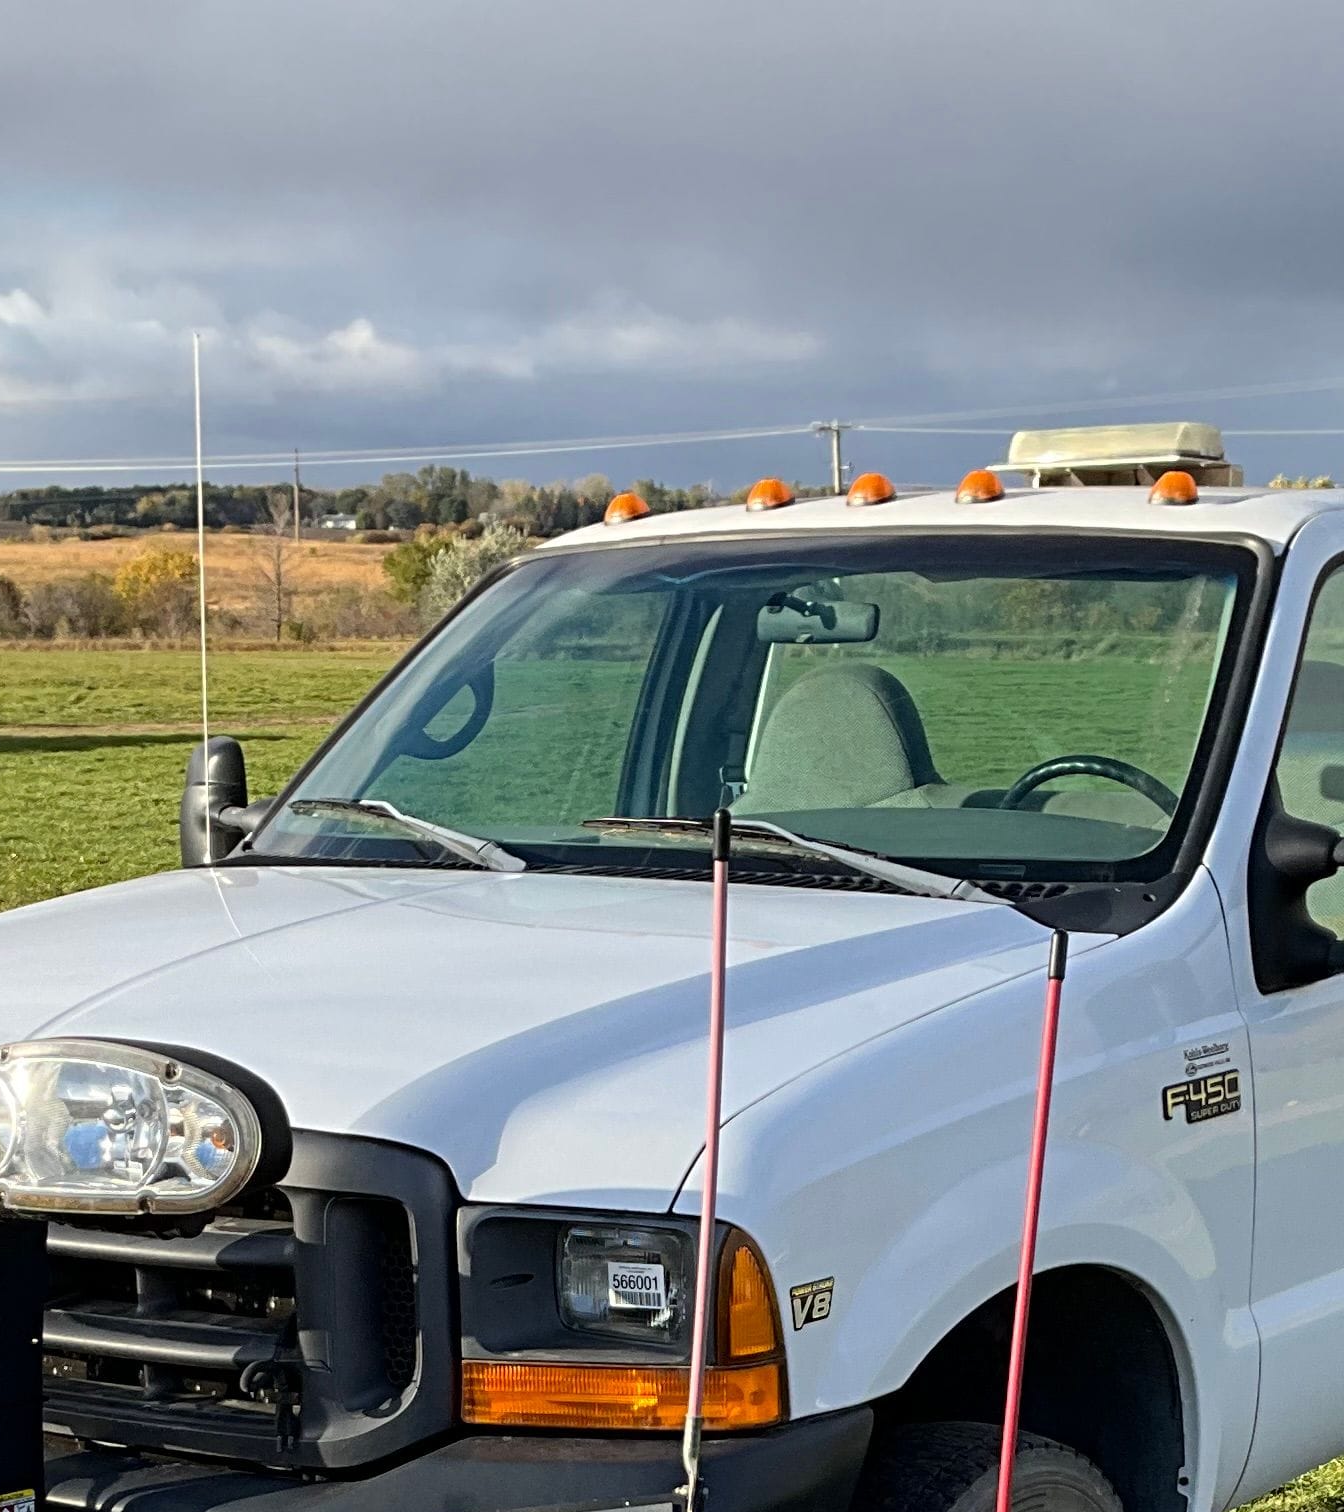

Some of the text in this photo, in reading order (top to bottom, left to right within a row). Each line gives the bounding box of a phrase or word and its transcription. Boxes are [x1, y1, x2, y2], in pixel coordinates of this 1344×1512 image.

[1166, 1071, 1240, 1118] F-450
[613, 1274, 658, 1291] 566001
[793, 1291, 832, 1329] V8
